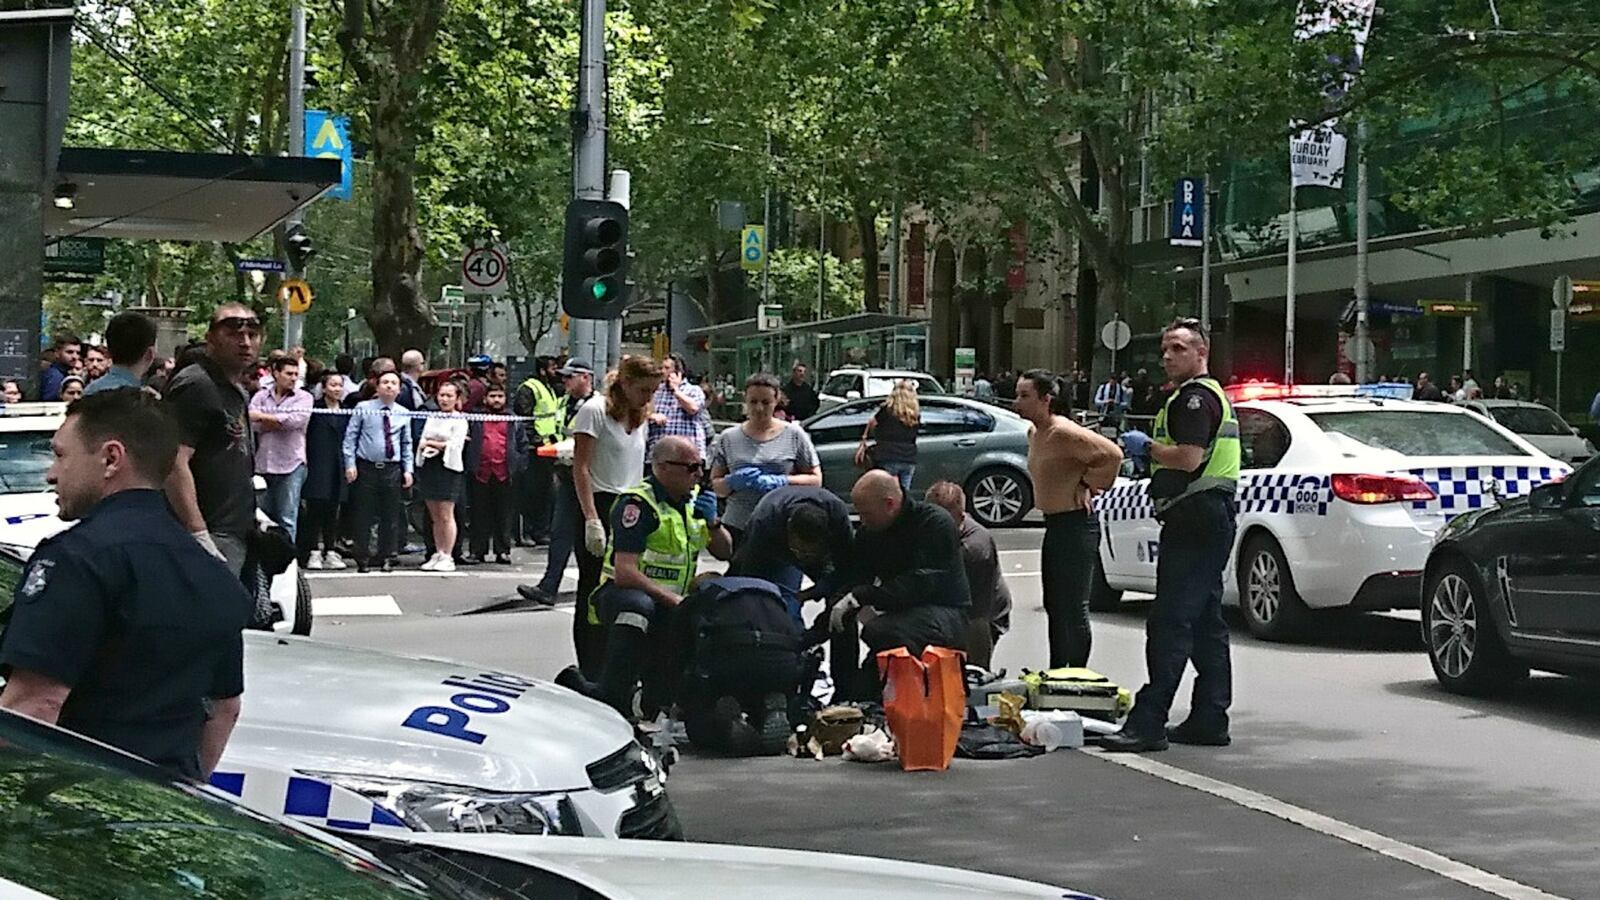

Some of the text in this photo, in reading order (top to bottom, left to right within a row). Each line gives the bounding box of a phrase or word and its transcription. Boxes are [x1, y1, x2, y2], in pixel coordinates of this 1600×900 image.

[1182, 180, 1194, 237] DRAMA
[468, 257, 500, 278] 40
[1296, 490, 1319, 503] 000
[644, 565, 680, 579] HEALTH
[401, 671, 541, 745] Polic
